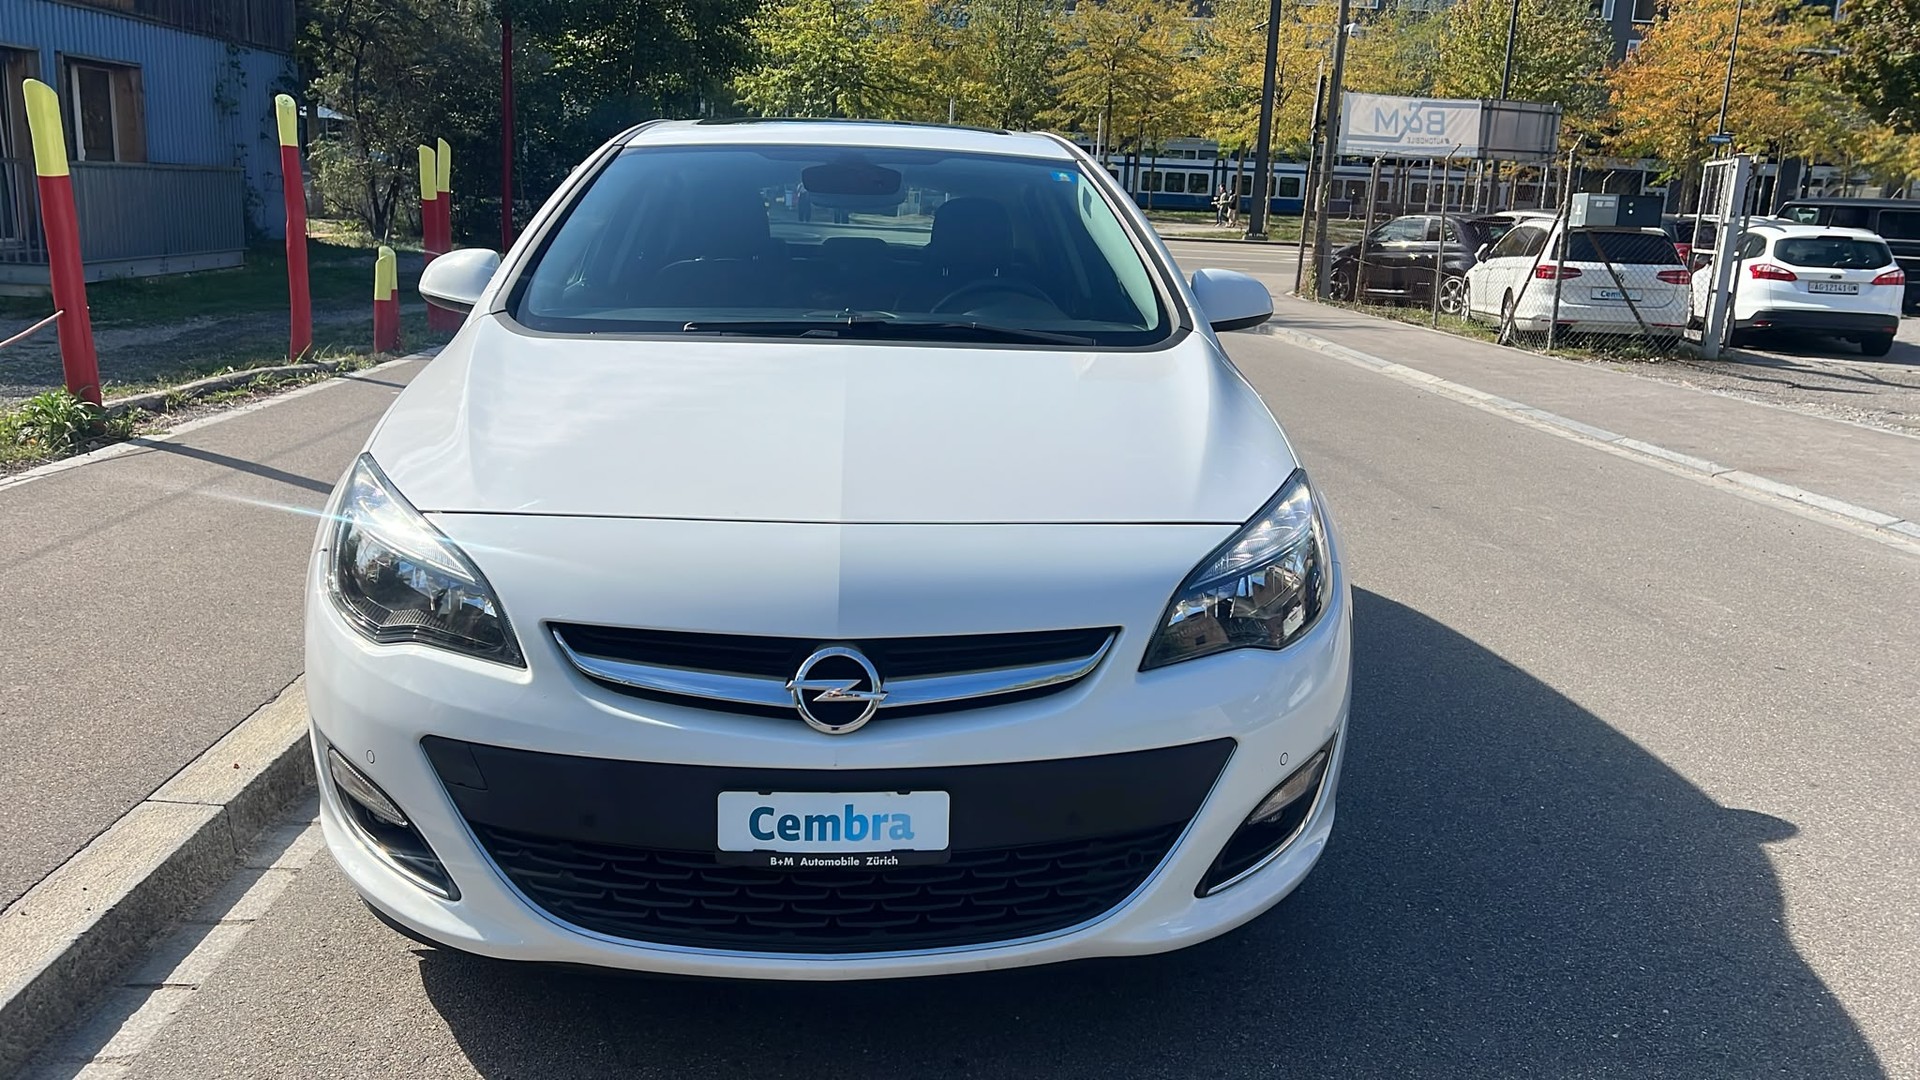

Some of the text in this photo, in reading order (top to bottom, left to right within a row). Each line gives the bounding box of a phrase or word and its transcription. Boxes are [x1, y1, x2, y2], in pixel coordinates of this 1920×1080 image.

[749, 804, 915, 842] Cembra
[770, 856, 899, 866] B+M Automobile Zürich
